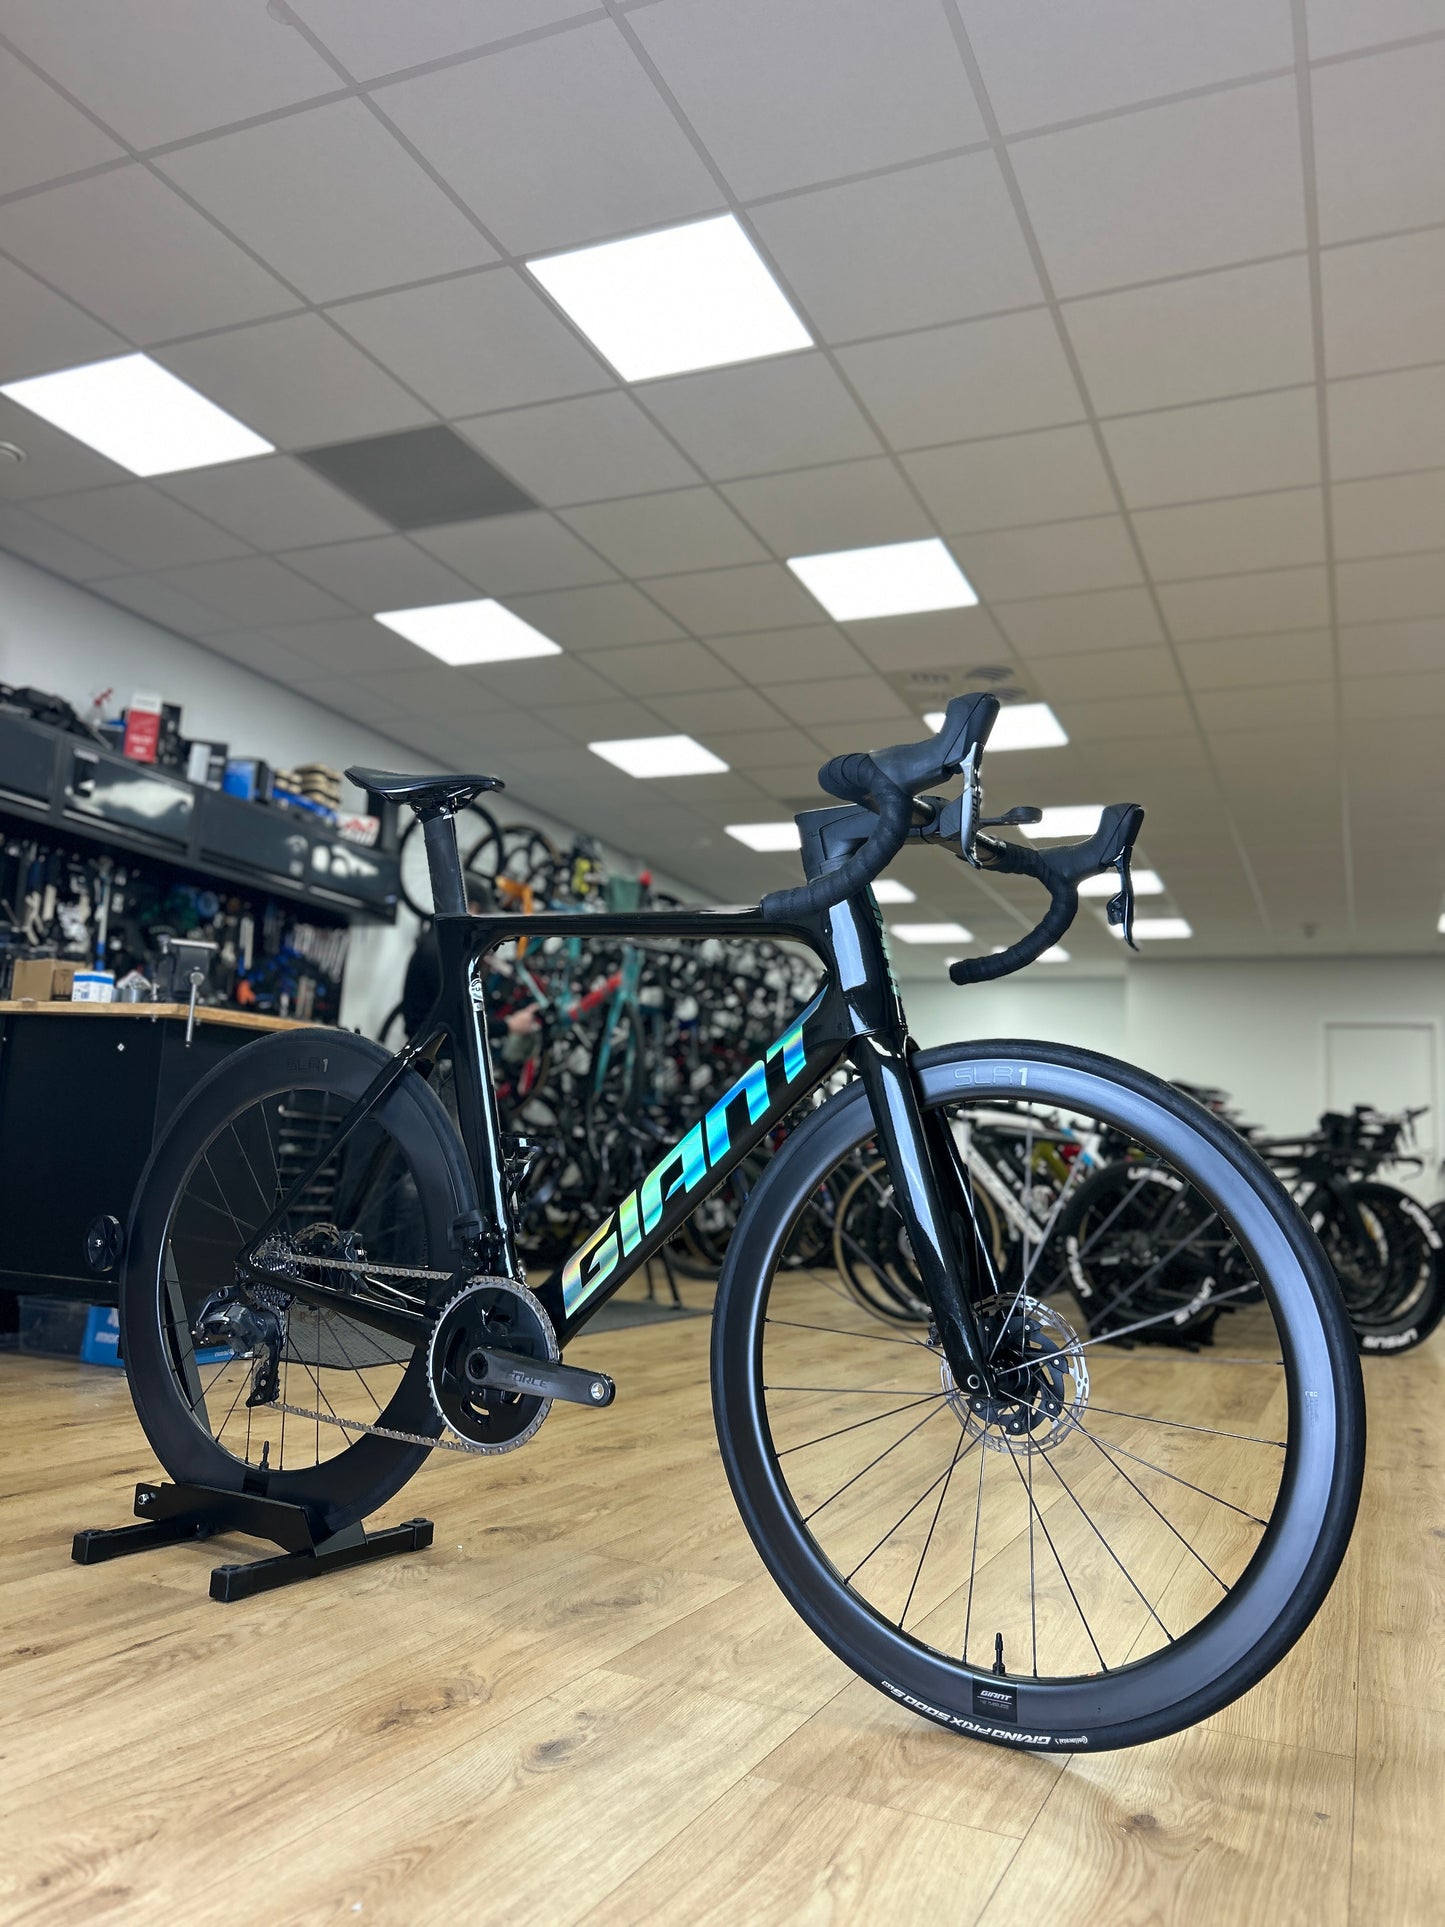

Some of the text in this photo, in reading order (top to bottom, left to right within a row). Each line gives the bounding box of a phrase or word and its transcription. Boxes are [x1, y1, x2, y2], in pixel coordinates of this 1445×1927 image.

[562, 984, 829, 1319] GIANT
[980, 1690, 1012, 1701] GIANT
[949, 1716, 992, 1735] PRIX
[991, 1729, 1051, 1744] GRAND
